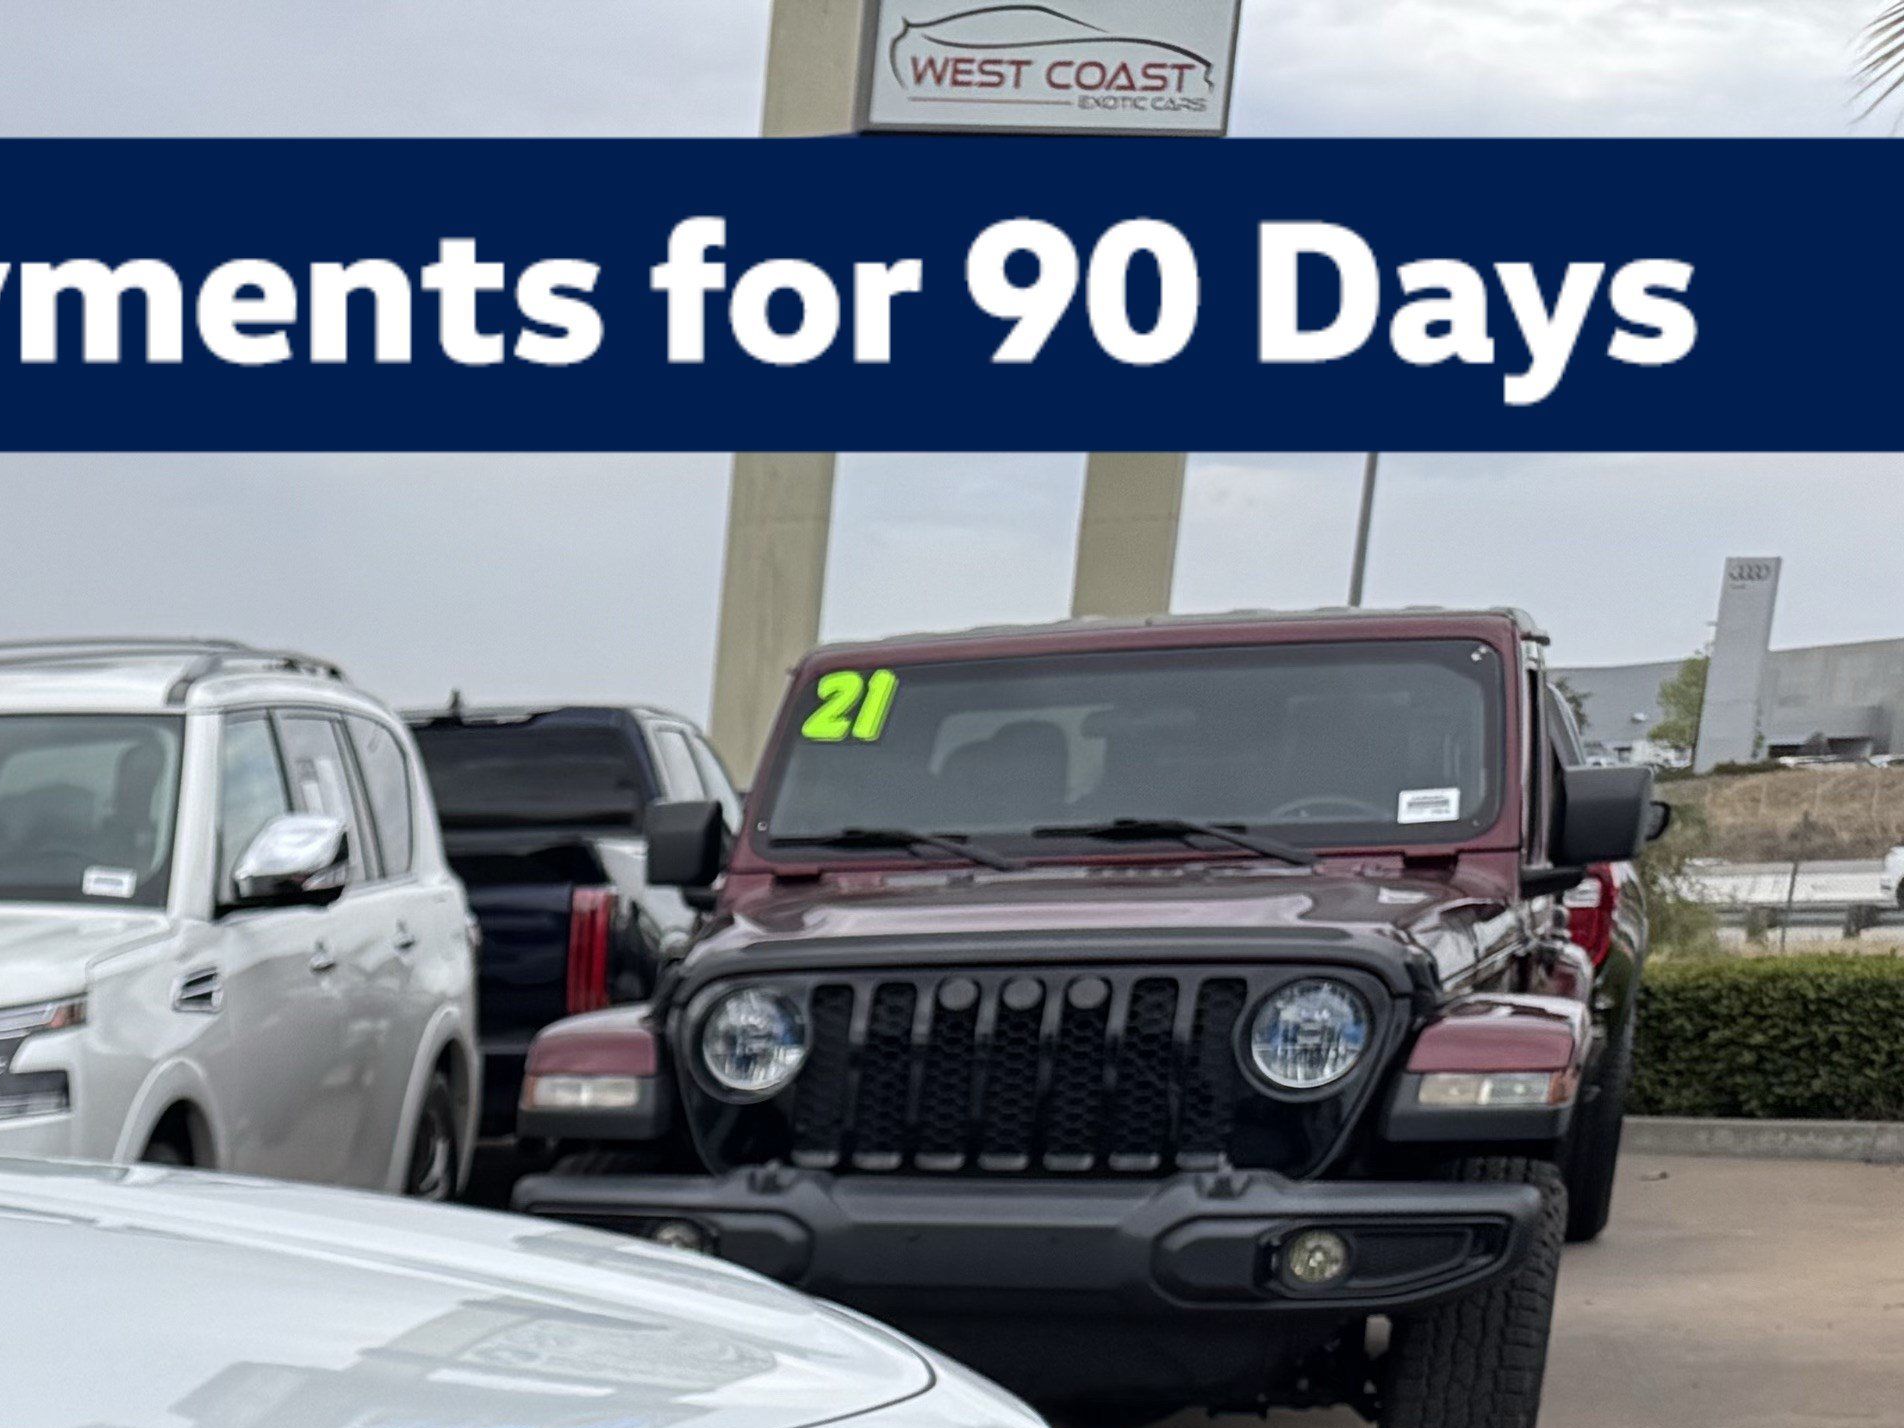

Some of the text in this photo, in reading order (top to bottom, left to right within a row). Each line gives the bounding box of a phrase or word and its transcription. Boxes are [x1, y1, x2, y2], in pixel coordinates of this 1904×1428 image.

[910, 56, 1197, 94] WEST COAST
[1077, 95, 1208, 113] EXOTIC CARS
[801, 668, 900, 742] 21
